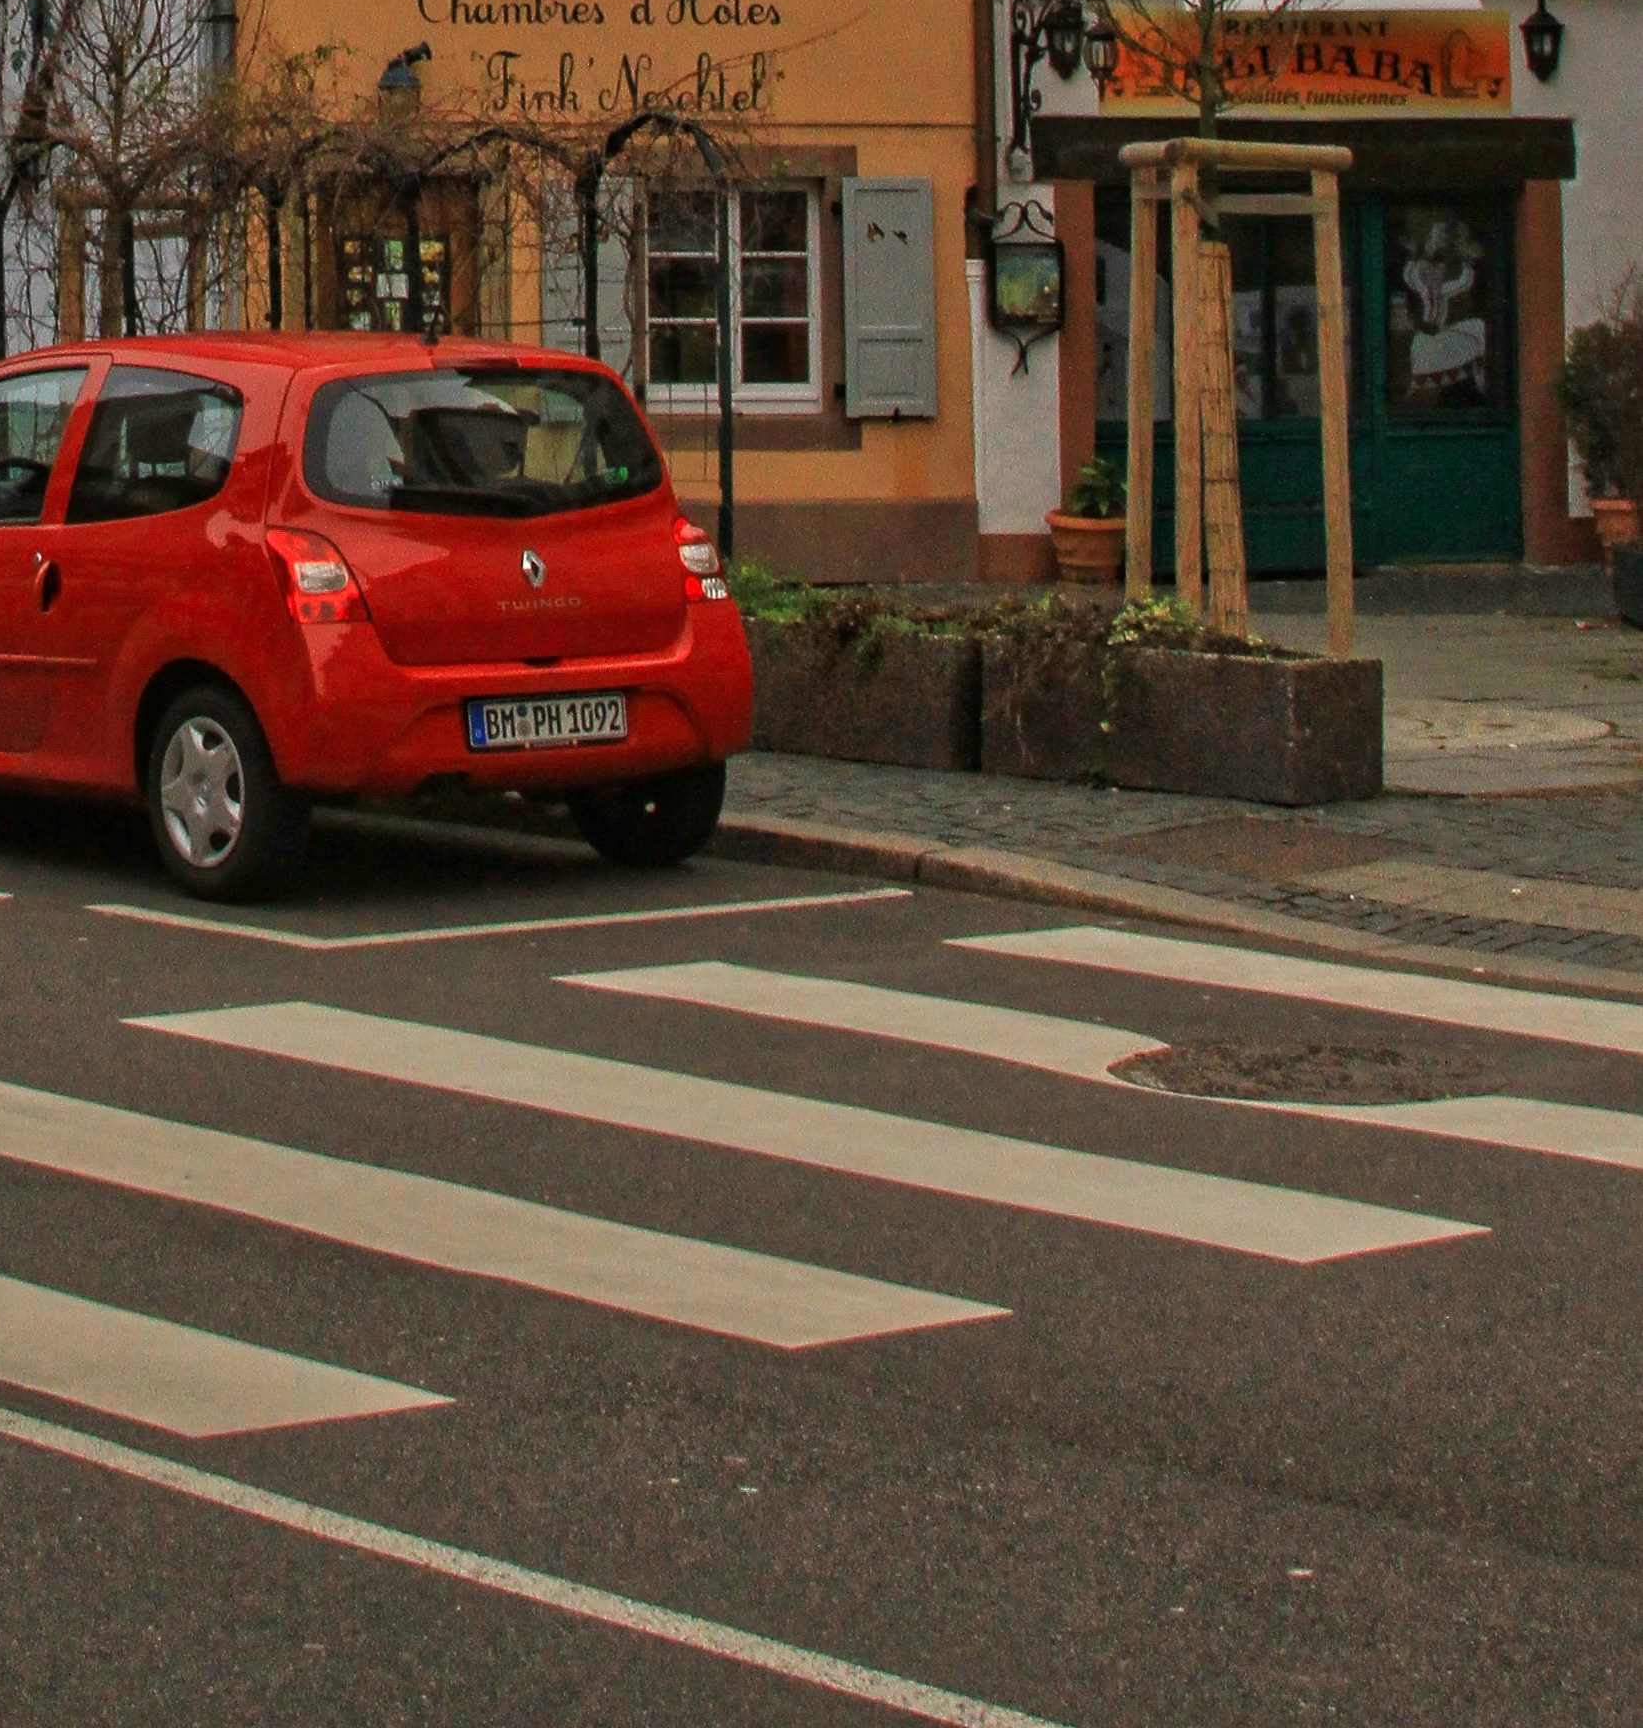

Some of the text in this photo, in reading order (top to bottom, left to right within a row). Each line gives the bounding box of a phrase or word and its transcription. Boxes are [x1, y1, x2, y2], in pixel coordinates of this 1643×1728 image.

[1295, 42, 1434, 96] BABA
[498, 598, 582, 611] TWINGO
[486, 700, 621, 740] BM PH 1092
